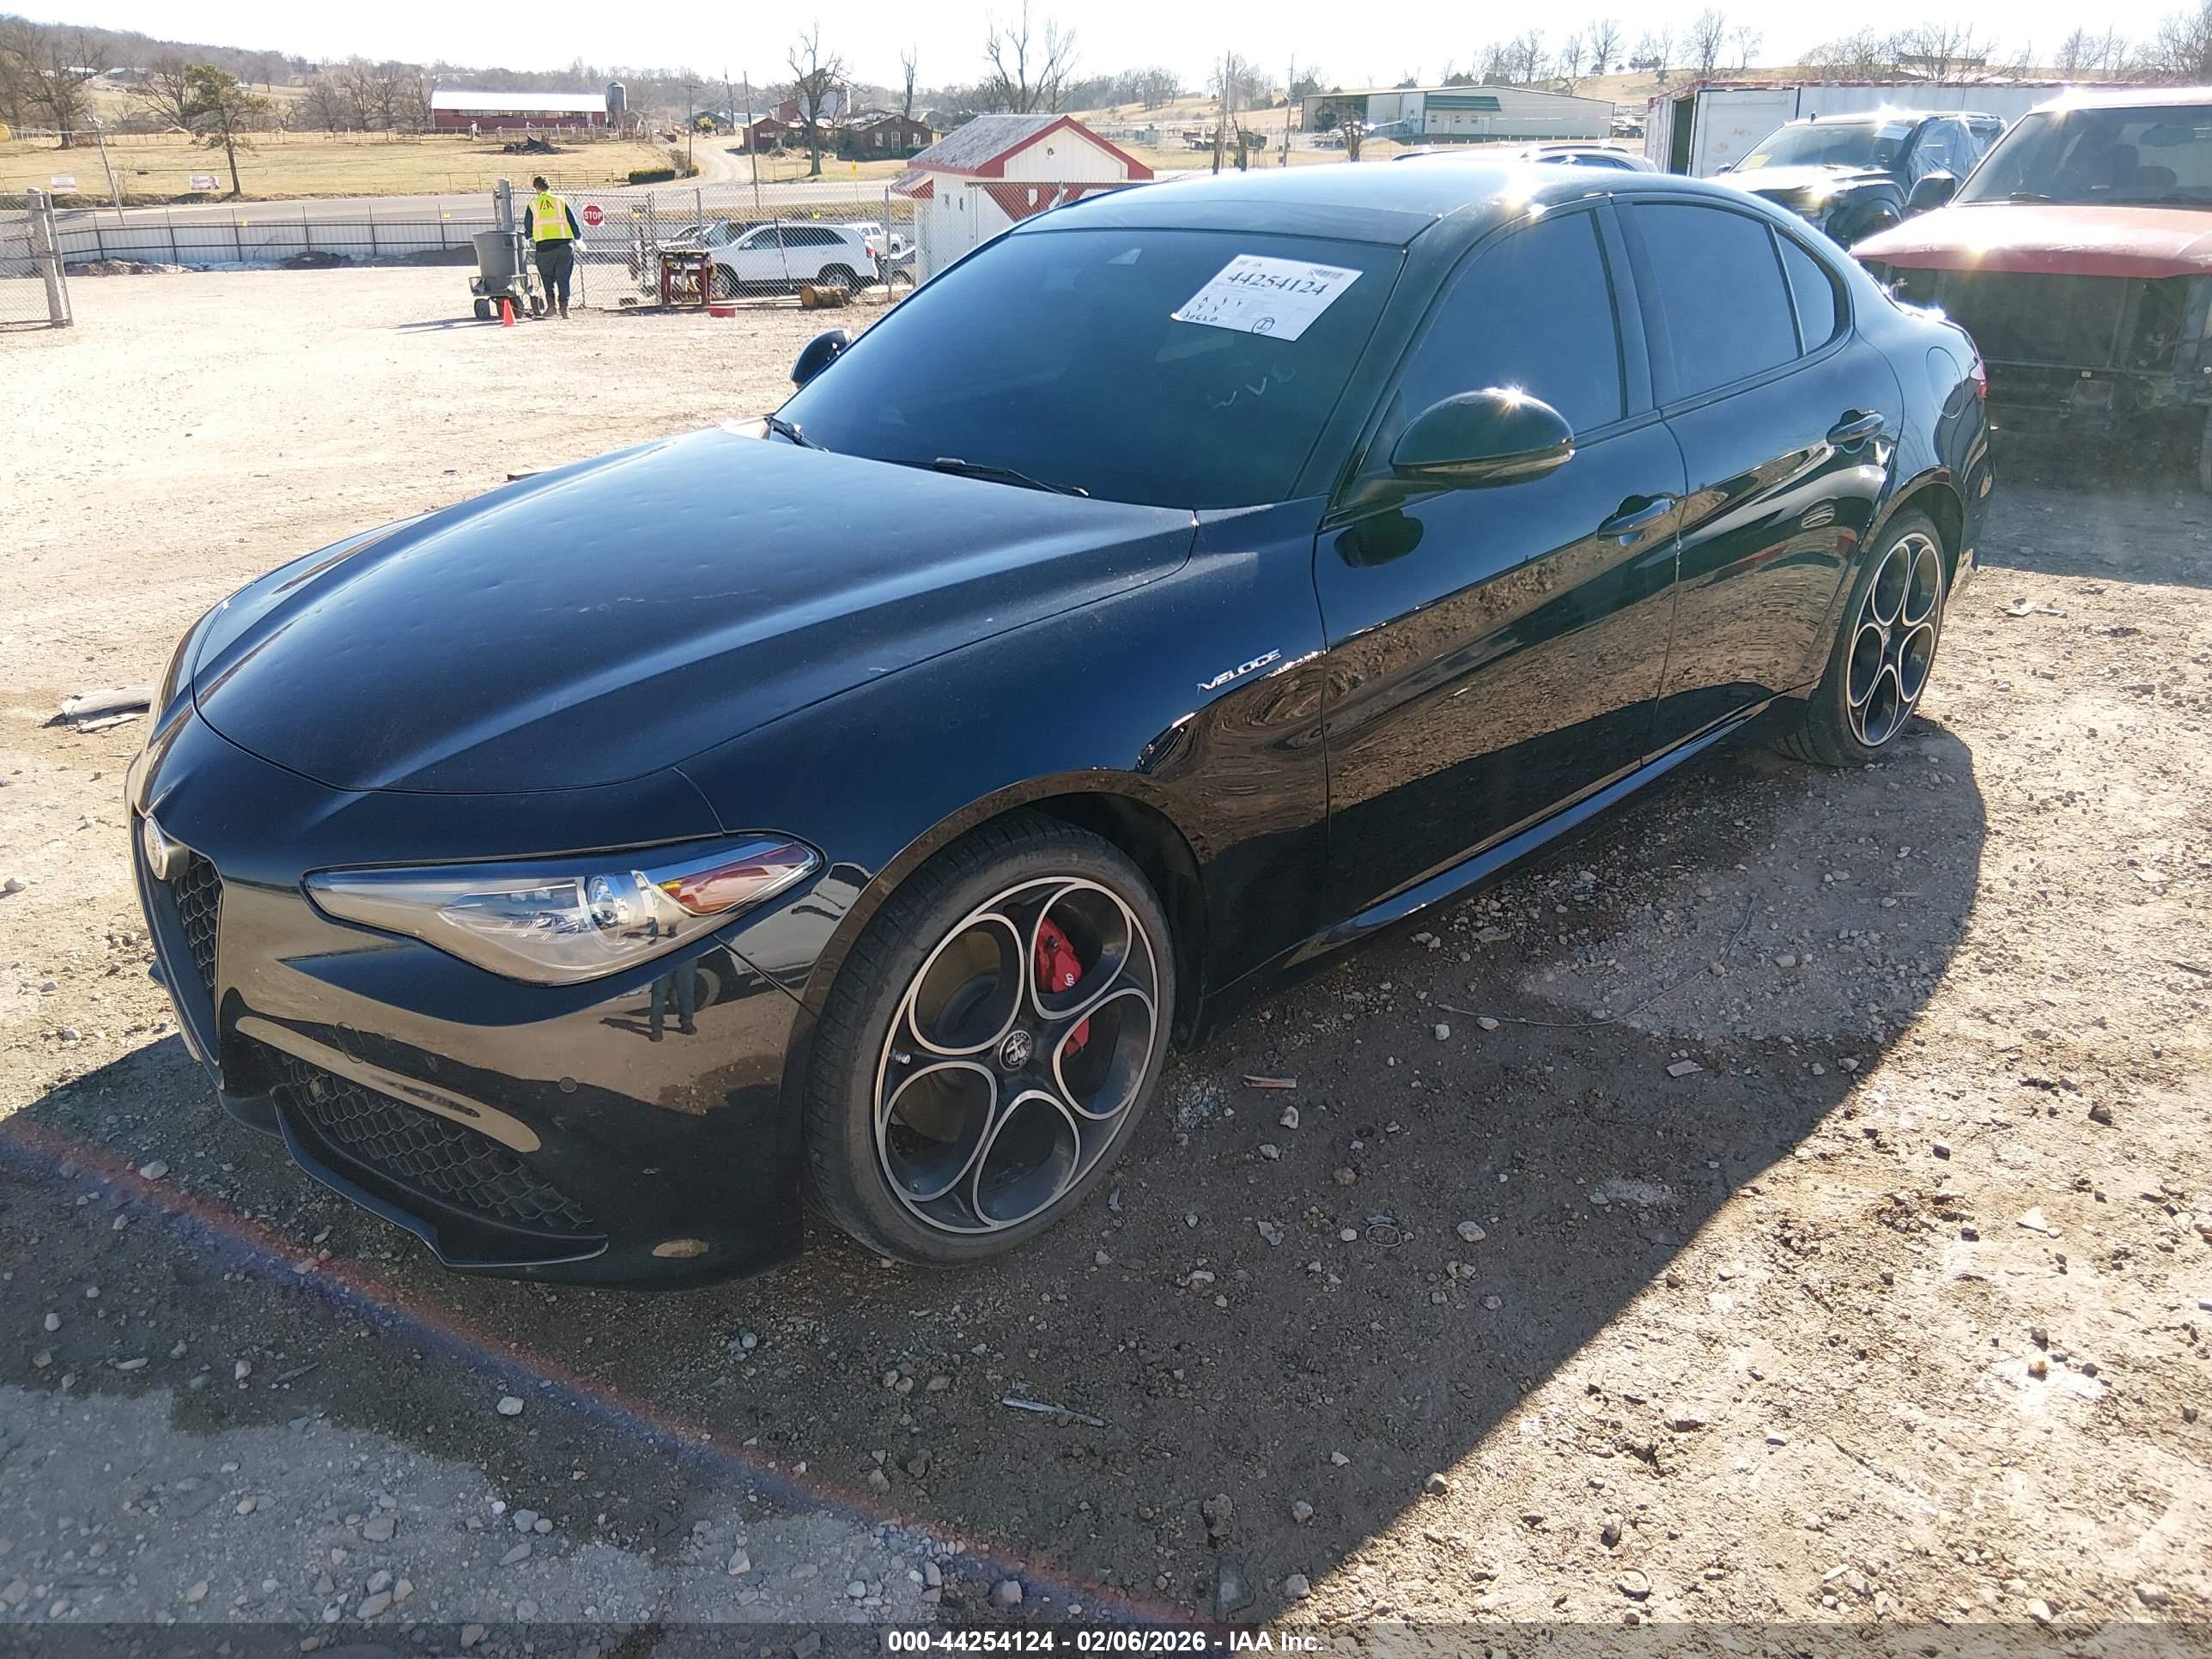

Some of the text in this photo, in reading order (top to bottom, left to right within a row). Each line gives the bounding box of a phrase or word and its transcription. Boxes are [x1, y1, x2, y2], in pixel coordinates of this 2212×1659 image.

[584, 211, 603, 221] STOP
[1228, 271, 1329, 296] 44254124
[1196, 648, 1281, 694] VELOCE
